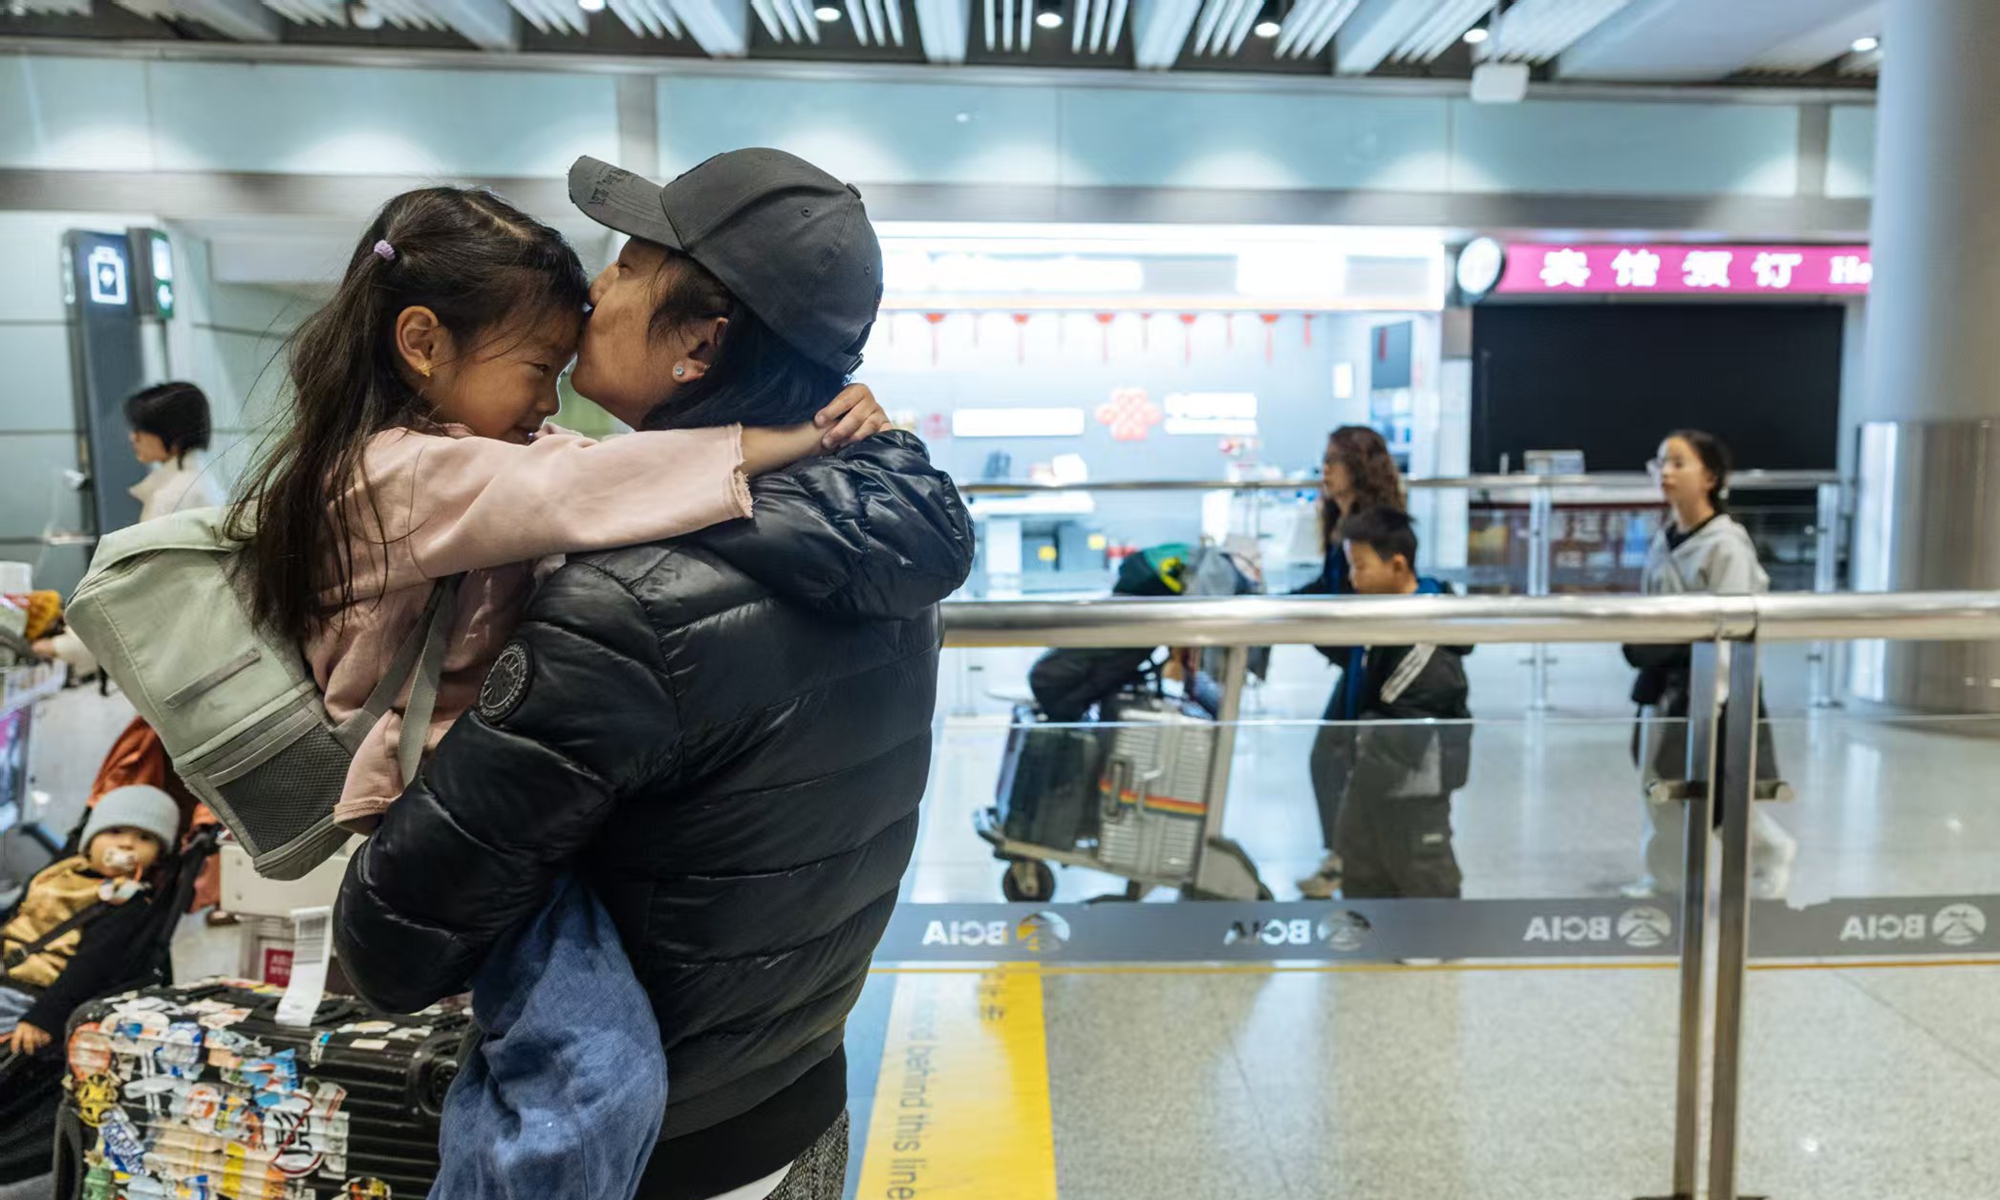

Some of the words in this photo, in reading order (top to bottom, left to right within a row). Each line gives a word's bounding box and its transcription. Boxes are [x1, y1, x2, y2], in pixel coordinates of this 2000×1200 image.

[900, 1044, 938, 1109] behind
[892, 1113, 931, 1151] this
[886, 1158, 927, 1200] line
